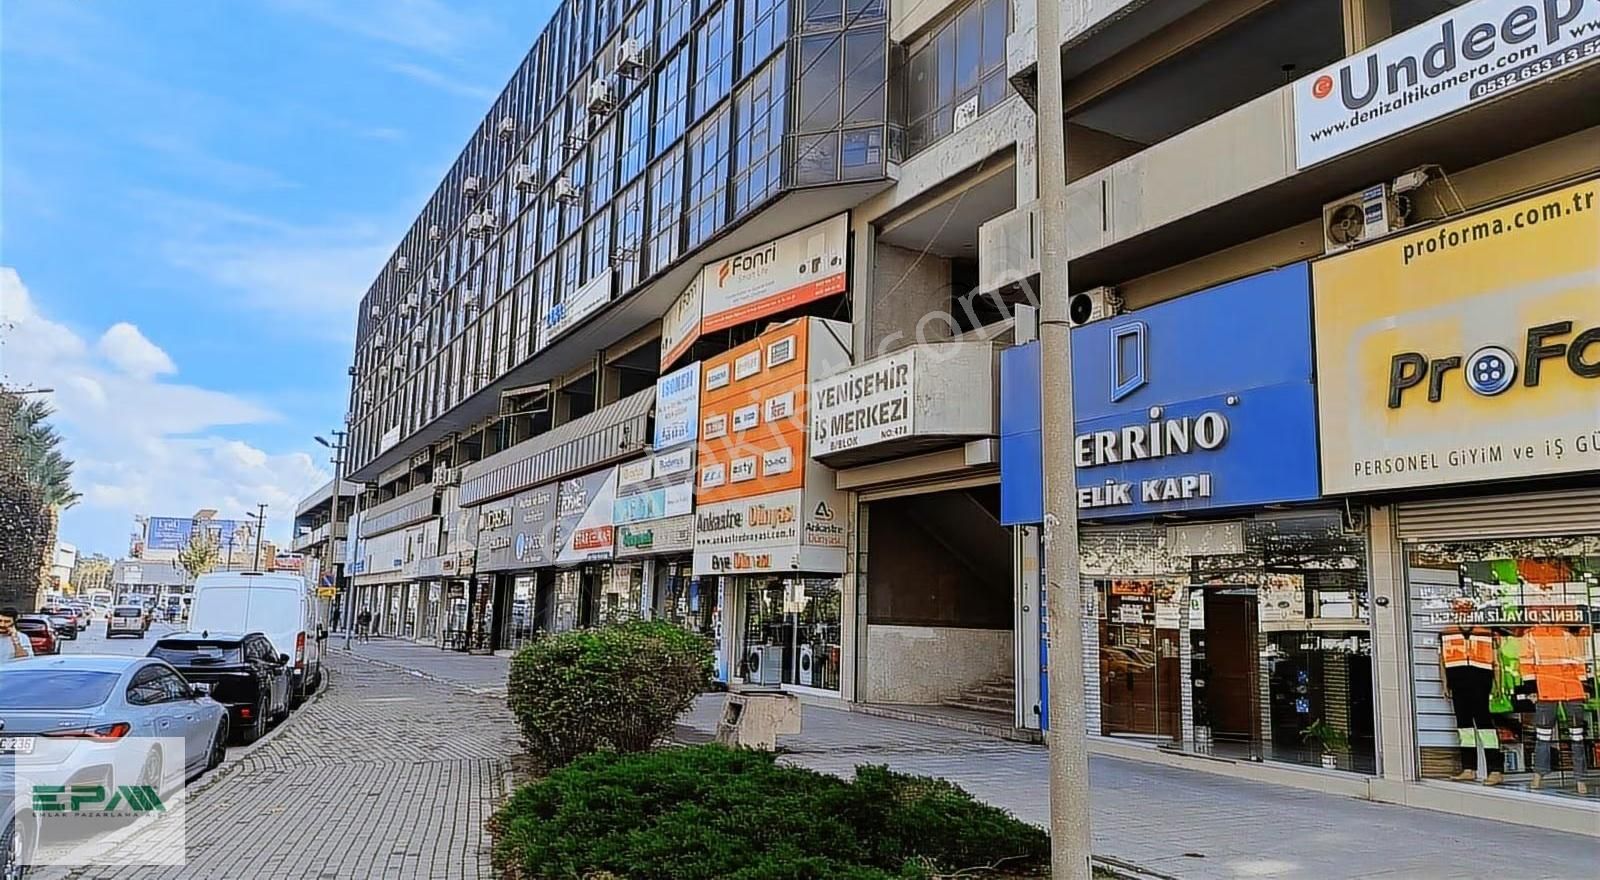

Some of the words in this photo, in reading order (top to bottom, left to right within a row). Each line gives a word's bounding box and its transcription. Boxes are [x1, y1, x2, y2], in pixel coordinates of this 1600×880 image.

[1310, 44, 1538, 143] www.denizaltikamera.com
[1478, 74, 1516, 97] 0532
[1520, 61, 1551, 80] 633
[1557, 48, 1578, 65] 13
[1403, 189, 1595, 265] proforma.com.tr
[732, 242, 776, 275] Fonri
[816, 361, 908, 411] YENİŞEHİR
[815, 414, 827, 444] İŞ
[830, 390, 908, 436] MERKEZİ
[1075, 405, 1229, 468] ERRİNO
[1354, 452, 1439, 477] PERSONEL
[1513, 446, 1534, 460] ve
[1078, 479, 1132, 509] ELİK
[1142, 472, 1211, 502] KAPI
[696, 508, 743, 534] Ankastre
